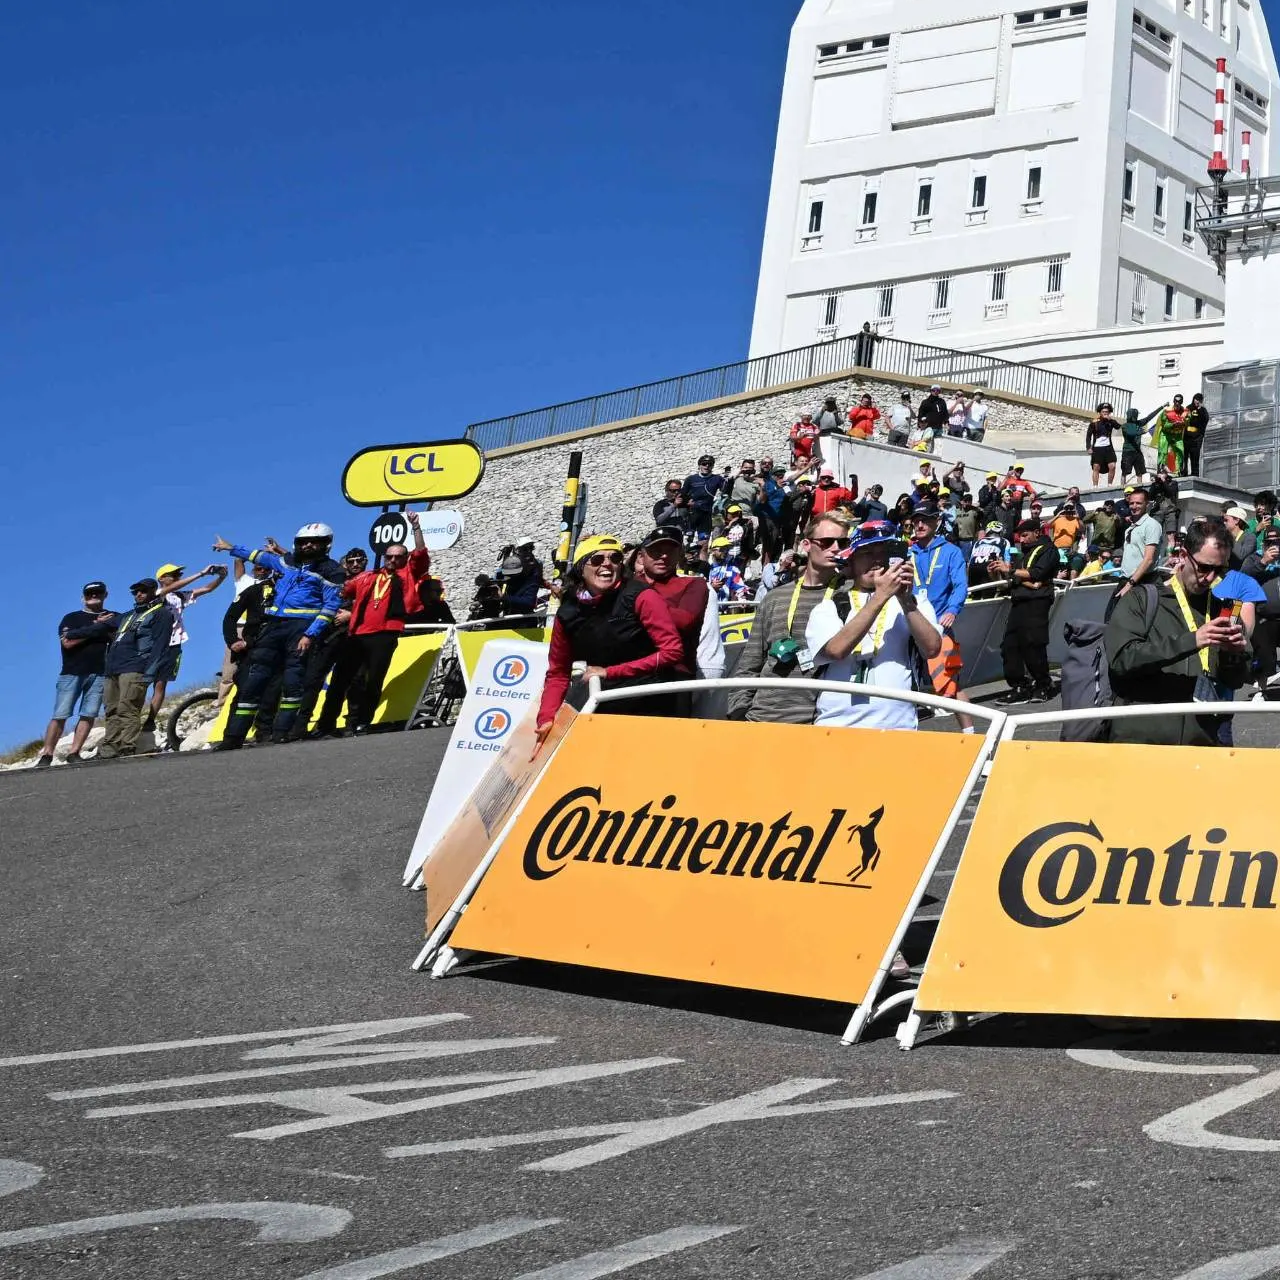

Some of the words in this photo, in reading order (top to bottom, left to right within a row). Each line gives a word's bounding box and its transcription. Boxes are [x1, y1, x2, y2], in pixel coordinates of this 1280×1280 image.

[390, 453, 444, 475] LCL
[374, 524, 404, 544] 100
[475, 686, 531, 700] E.Leclerc
[456, 740, 505, 752] E.Lecle
[522, 785, 848, 885] Continental
